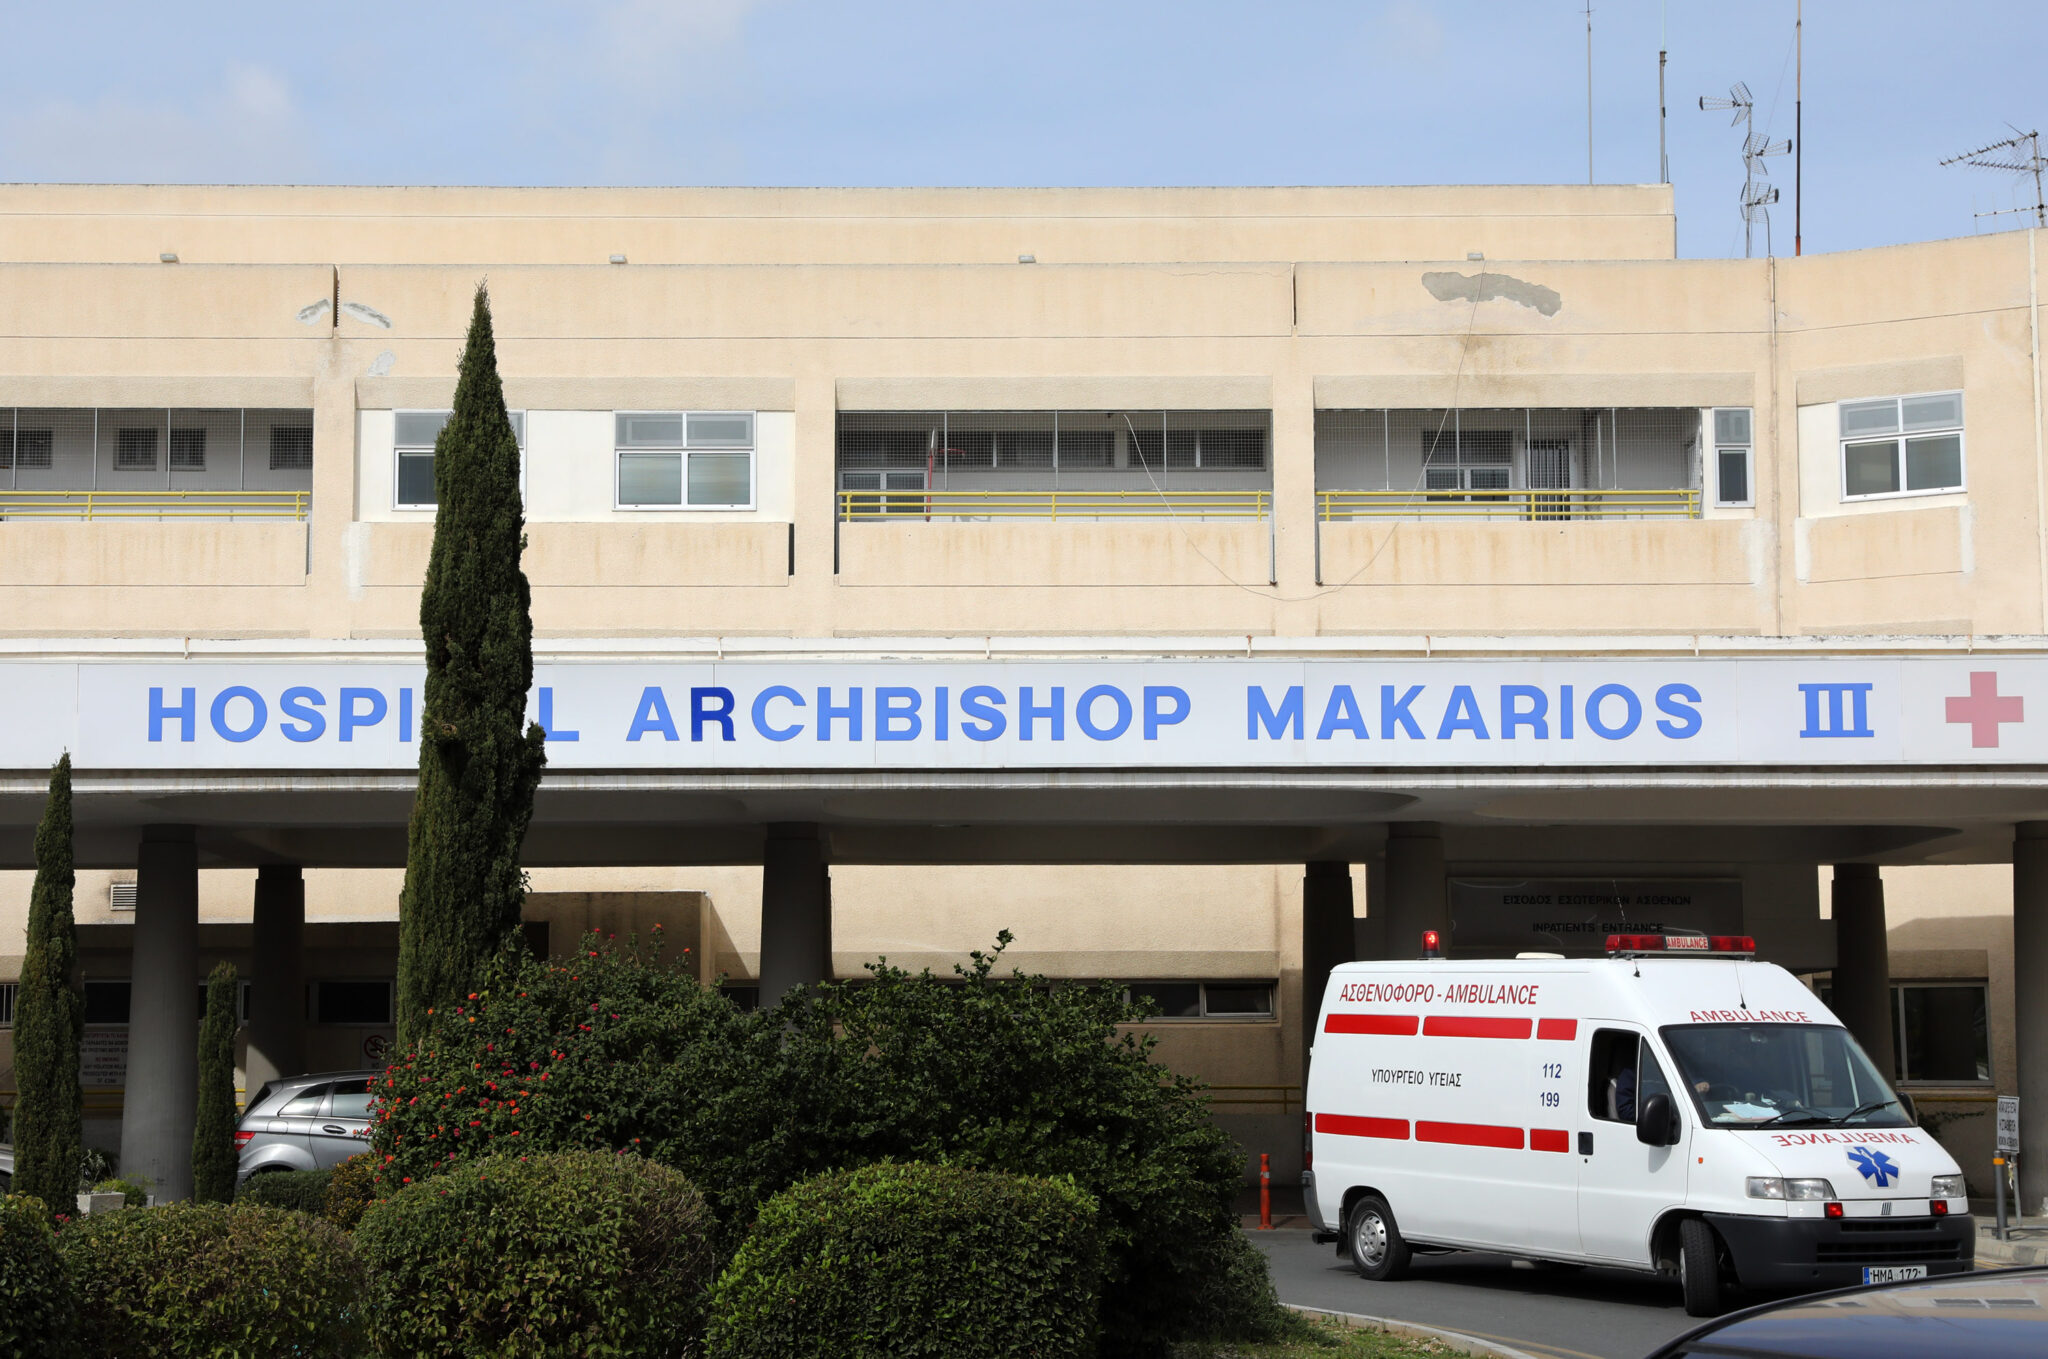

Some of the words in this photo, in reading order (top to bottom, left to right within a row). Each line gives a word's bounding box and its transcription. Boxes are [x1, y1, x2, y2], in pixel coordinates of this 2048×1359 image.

[148, 685, 580, 742] HOSPIL
[625, 685, 1191, 742] ARCHBISHOP
[1247, 683, 1703, 740] MAKARIOS
[1798, 682, 1875, 738] III
[1503, 895, 1552, 905] ΕΙΣΟΔΟΣ
[1532, 922, 1596, 933] INPATIENTS
[1602, 922, 1664, 933] ENTRANCE
[1666, 937, 1708, 949] AMBULANCE
[1339, 983, 1434, 1003] ΑΣΘΕΝΟΦΟΡΟ
[1444, 984, 1539, 1005] AMBULANCE
[1690, 1010, 1813, 1023] AMBULANCE
[1371, 1069, 1424, 1085] ΥΠΟΥΡΓΕΙΟ
[1429, 1072, 1462, 1088] ΥΓΕΙΑΣ
[1542, 1063, 1562, 1079] 112
[1539, 1092, 1560, 1108] 199
[1872, 1269, 1894, 1283] HMA
